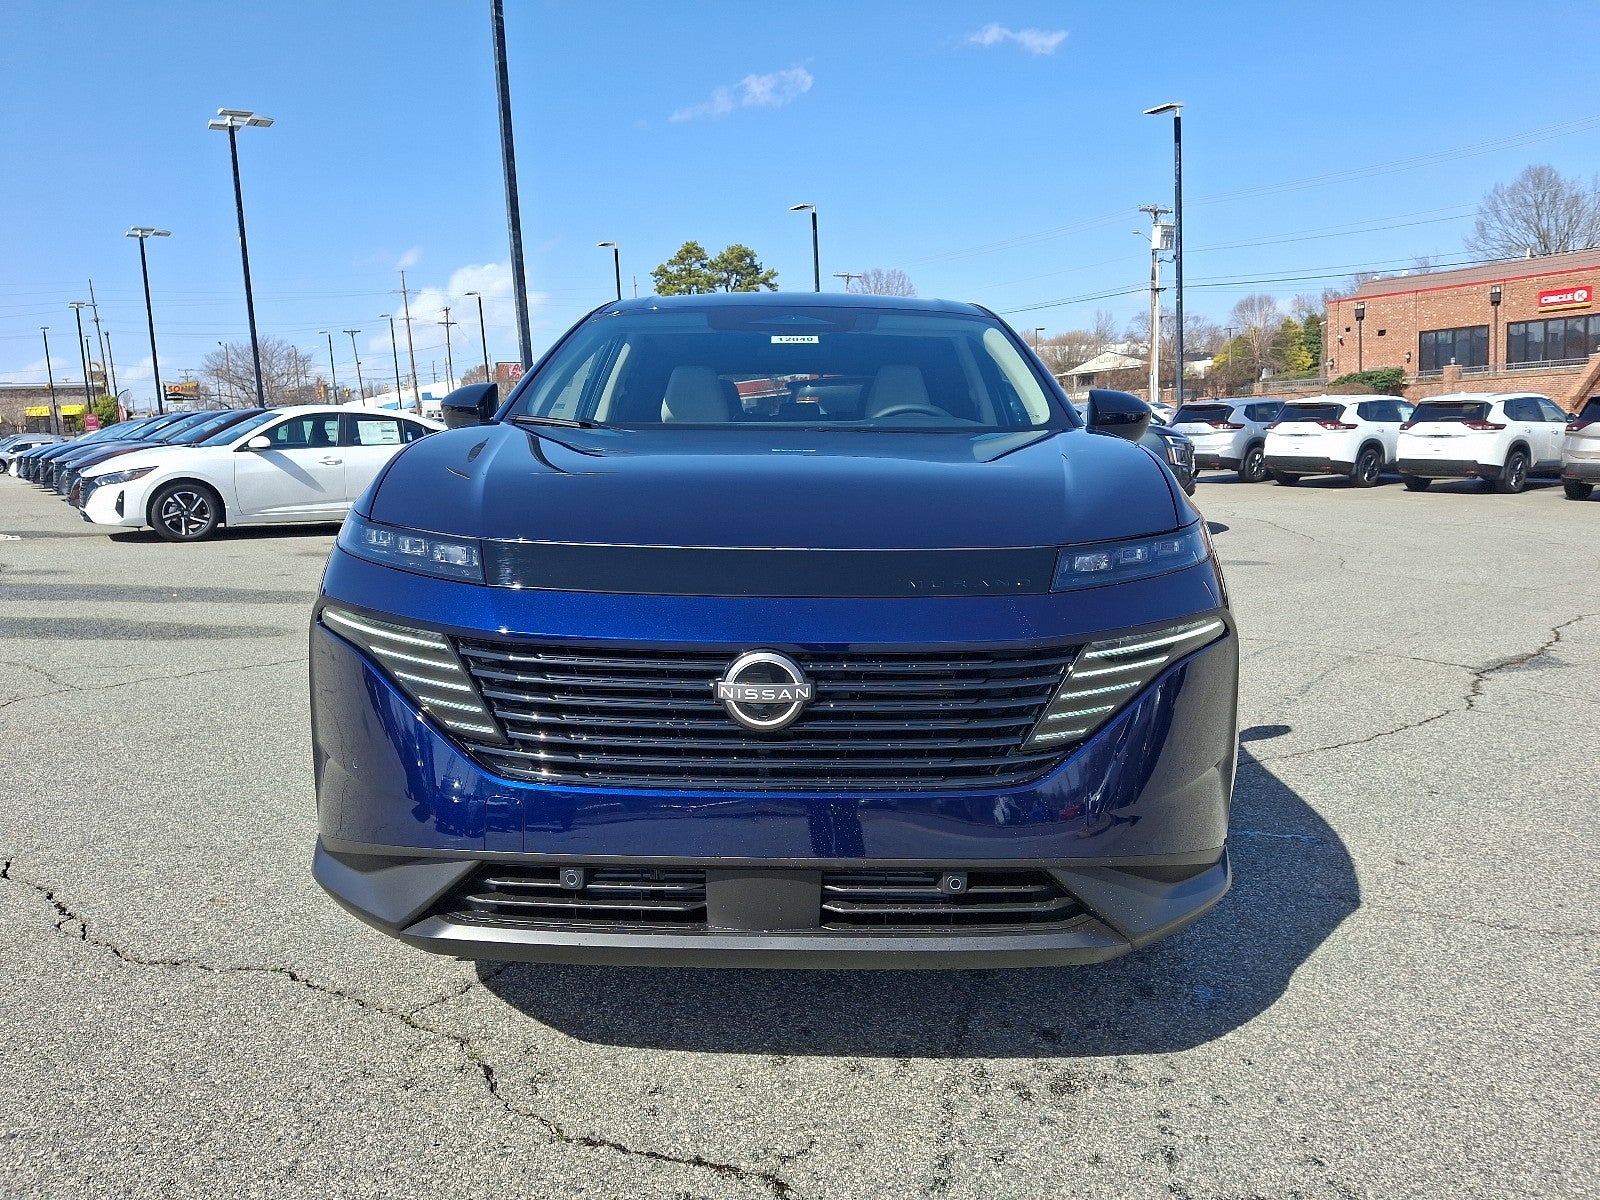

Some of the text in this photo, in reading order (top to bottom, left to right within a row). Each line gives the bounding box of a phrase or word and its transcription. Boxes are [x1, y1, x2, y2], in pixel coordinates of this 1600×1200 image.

[1541, 291, 1586, 304] CIRCLE K
[168, 385, 198, 393] SONIC
[720, 686, 809, 700] NISSAN
